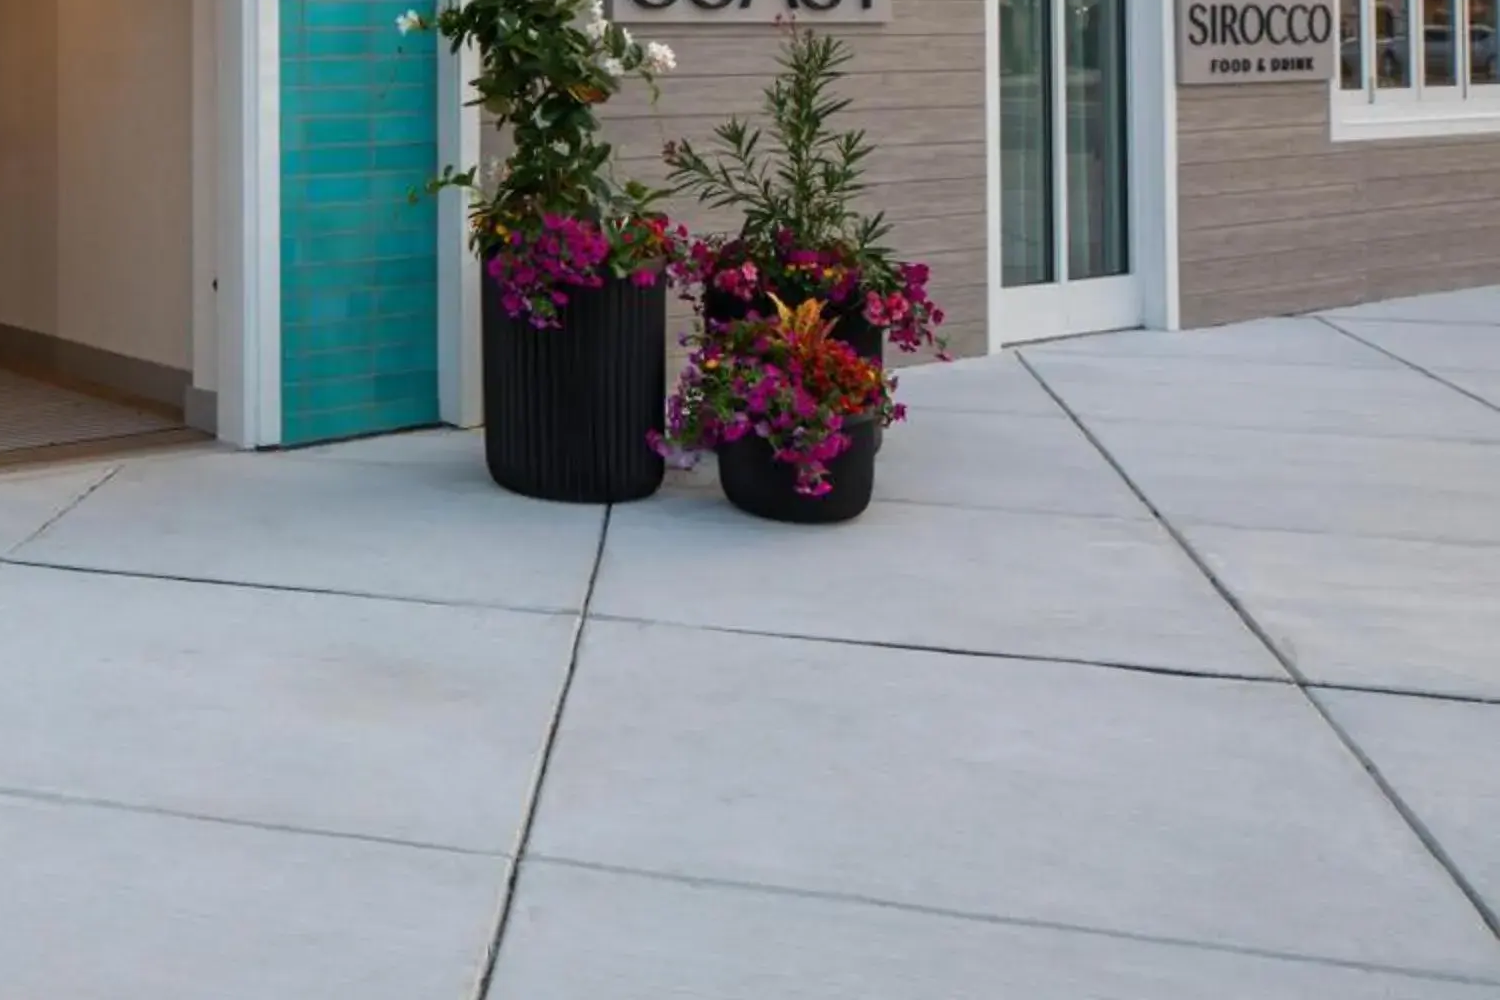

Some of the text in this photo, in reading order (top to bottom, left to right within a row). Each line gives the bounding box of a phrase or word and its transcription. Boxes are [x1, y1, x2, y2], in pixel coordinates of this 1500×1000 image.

[1188, 3, 1332, 46] SIROCCO
[1210, 56, 1315, 74] FOOD & DRINK
